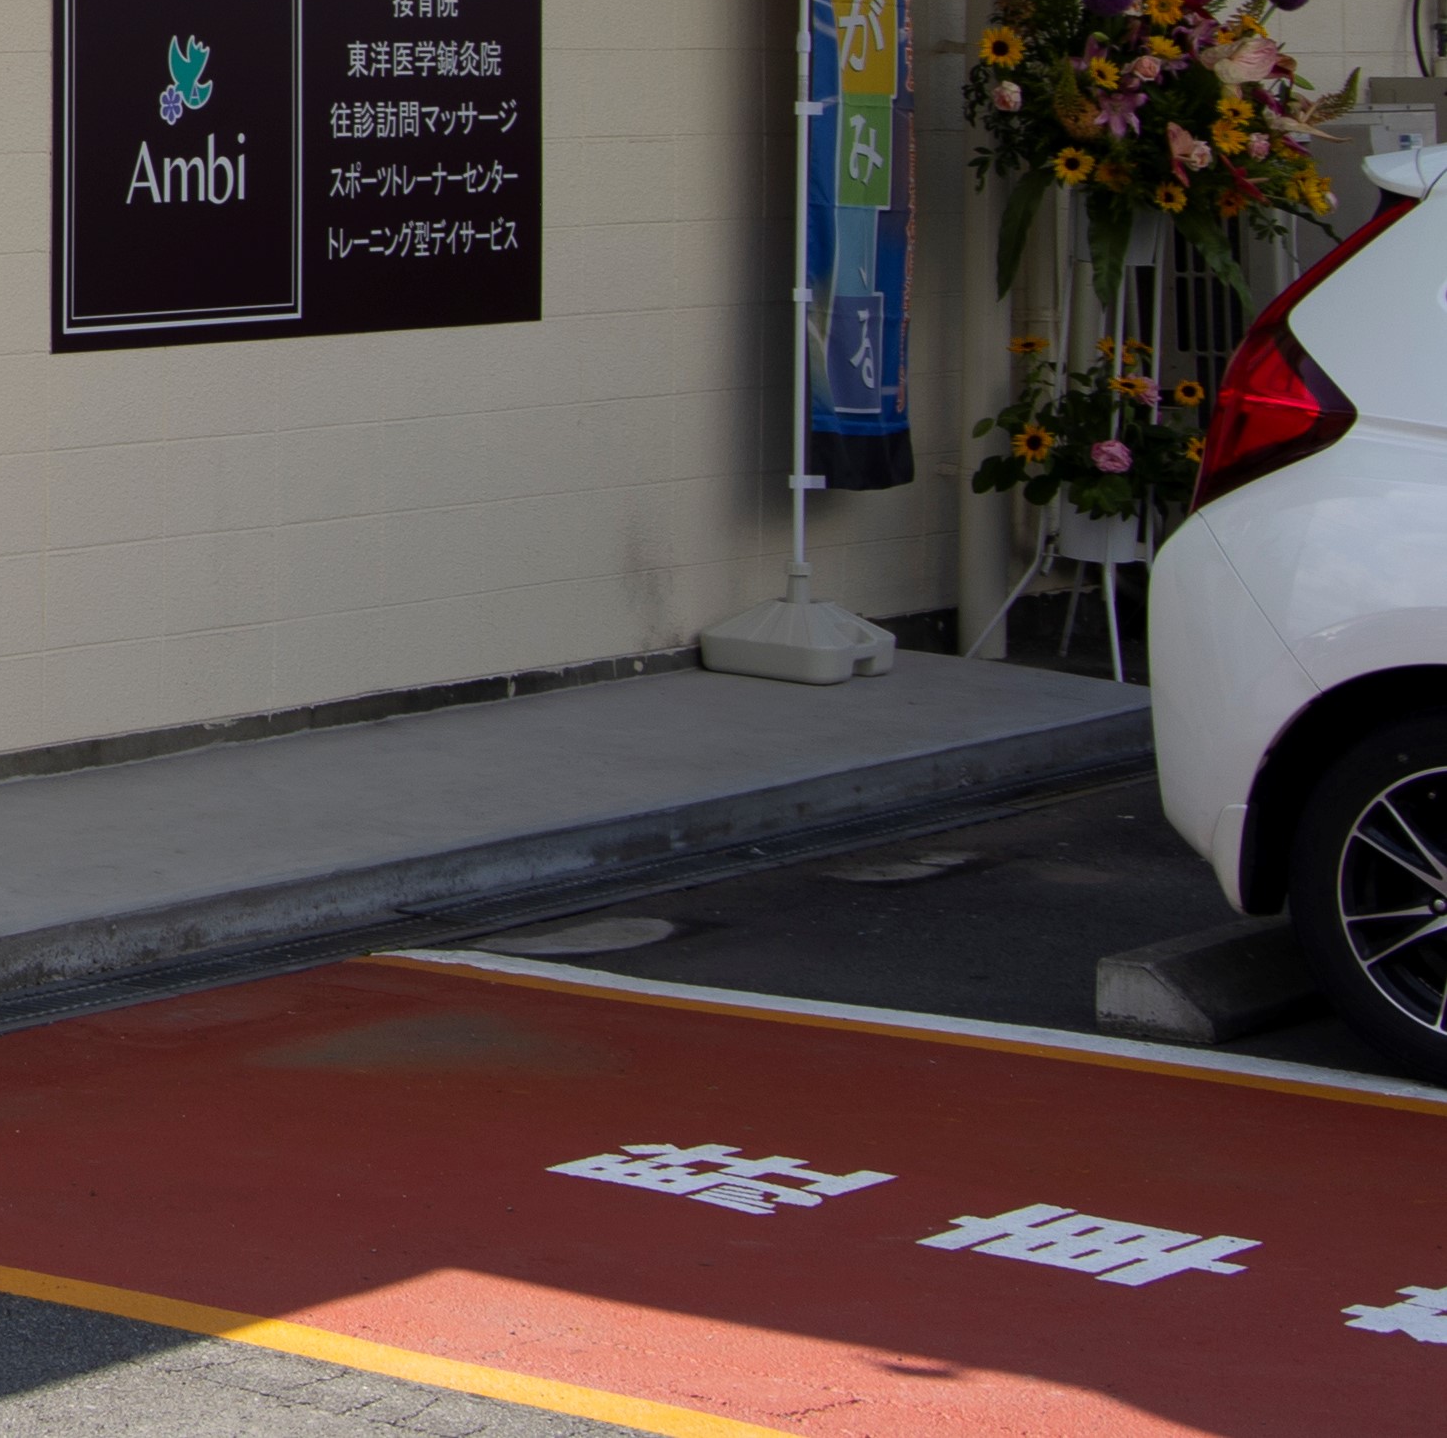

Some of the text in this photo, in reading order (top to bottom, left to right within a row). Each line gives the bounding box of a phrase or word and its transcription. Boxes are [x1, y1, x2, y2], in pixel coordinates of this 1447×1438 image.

[347, 40, 502, 78] 東洋医学鍼灸院
[330, 99, 518, 139] 往診訪問マッサージ
[126, 133, 246, 205] Ambi
[329, 160, 519, 199] スポーツトレーナーセンター
[328, 217, 519, 260] トレーニング型デイサービス
[544, 1142, 1447, 1346] 駐車
